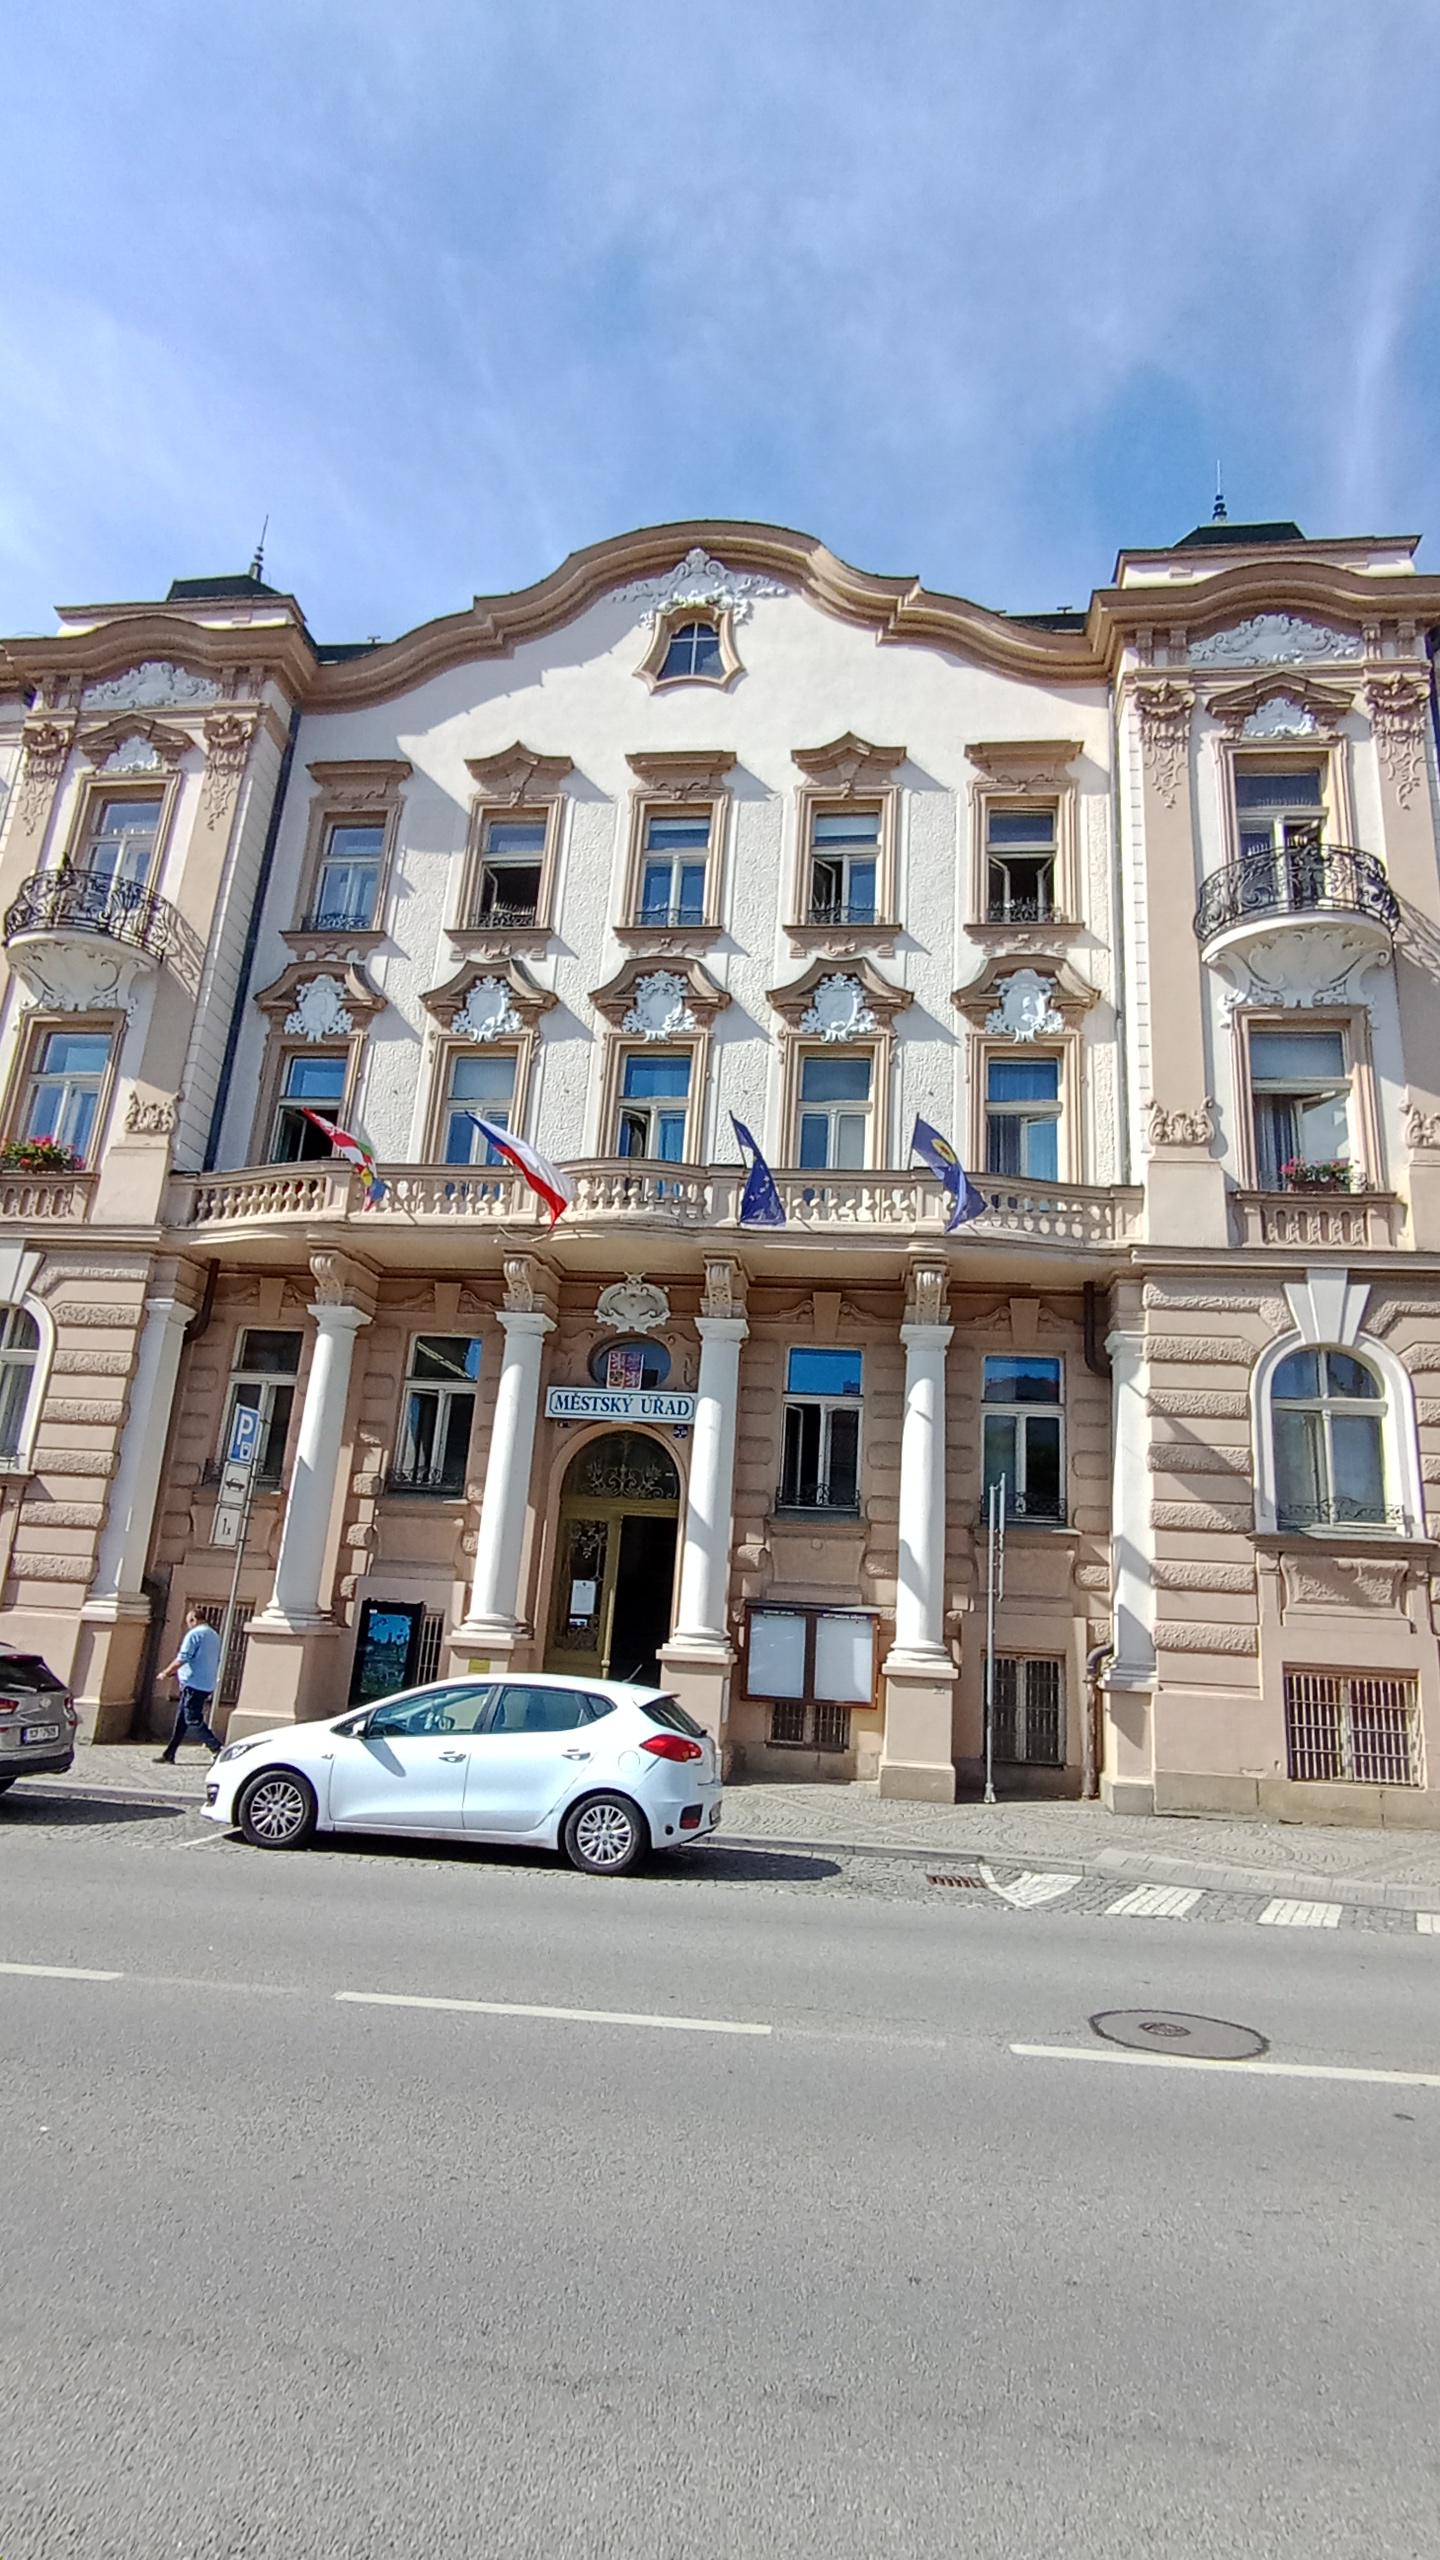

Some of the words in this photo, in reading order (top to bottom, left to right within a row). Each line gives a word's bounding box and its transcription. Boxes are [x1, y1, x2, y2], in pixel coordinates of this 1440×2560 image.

[554, 1392, 633, 1413] MĚSTSKÝ
[641, 1395, 690, 1416] ÚŘAD
[237, 1413, 254, 1445] P
